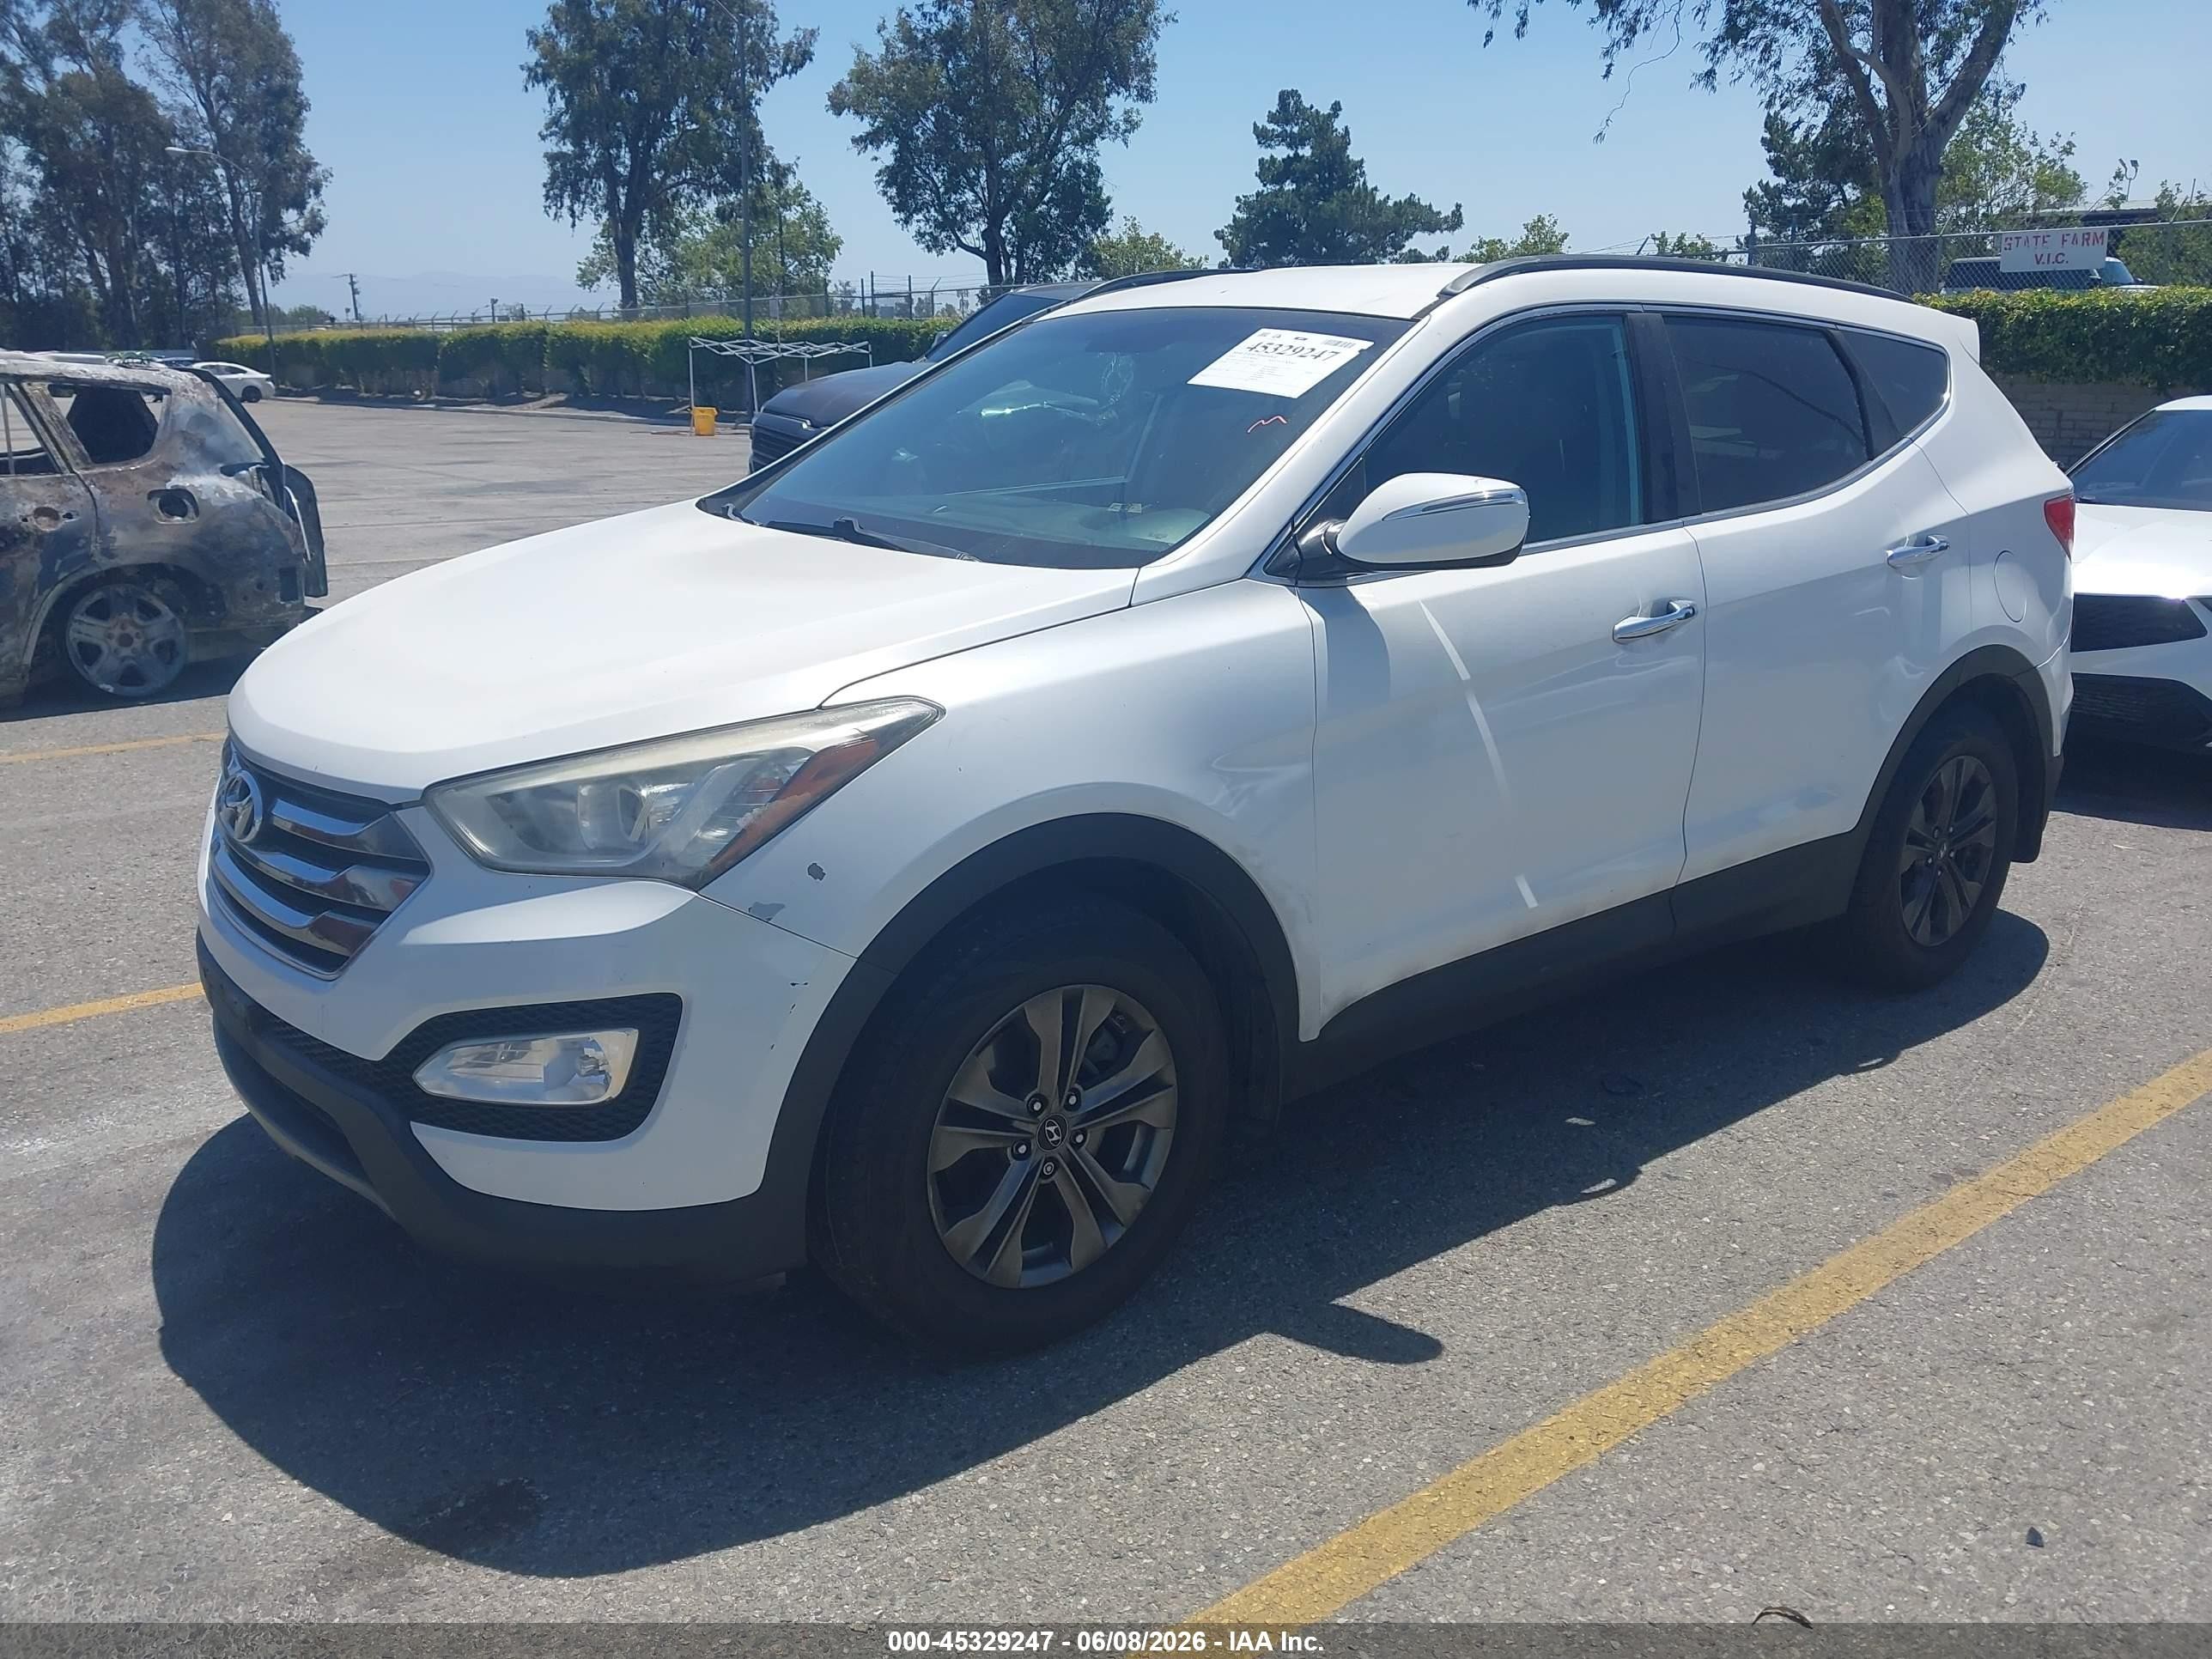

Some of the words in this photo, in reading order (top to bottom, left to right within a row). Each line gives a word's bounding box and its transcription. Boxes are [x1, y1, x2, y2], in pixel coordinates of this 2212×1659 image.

[2003, 235, 2052, 251] STATE
[2061, 231, 2104, 247] FARM
[2034, 252, 2069, 265] V.I.C.
[1246, 342, 1340, 362] 45329247
